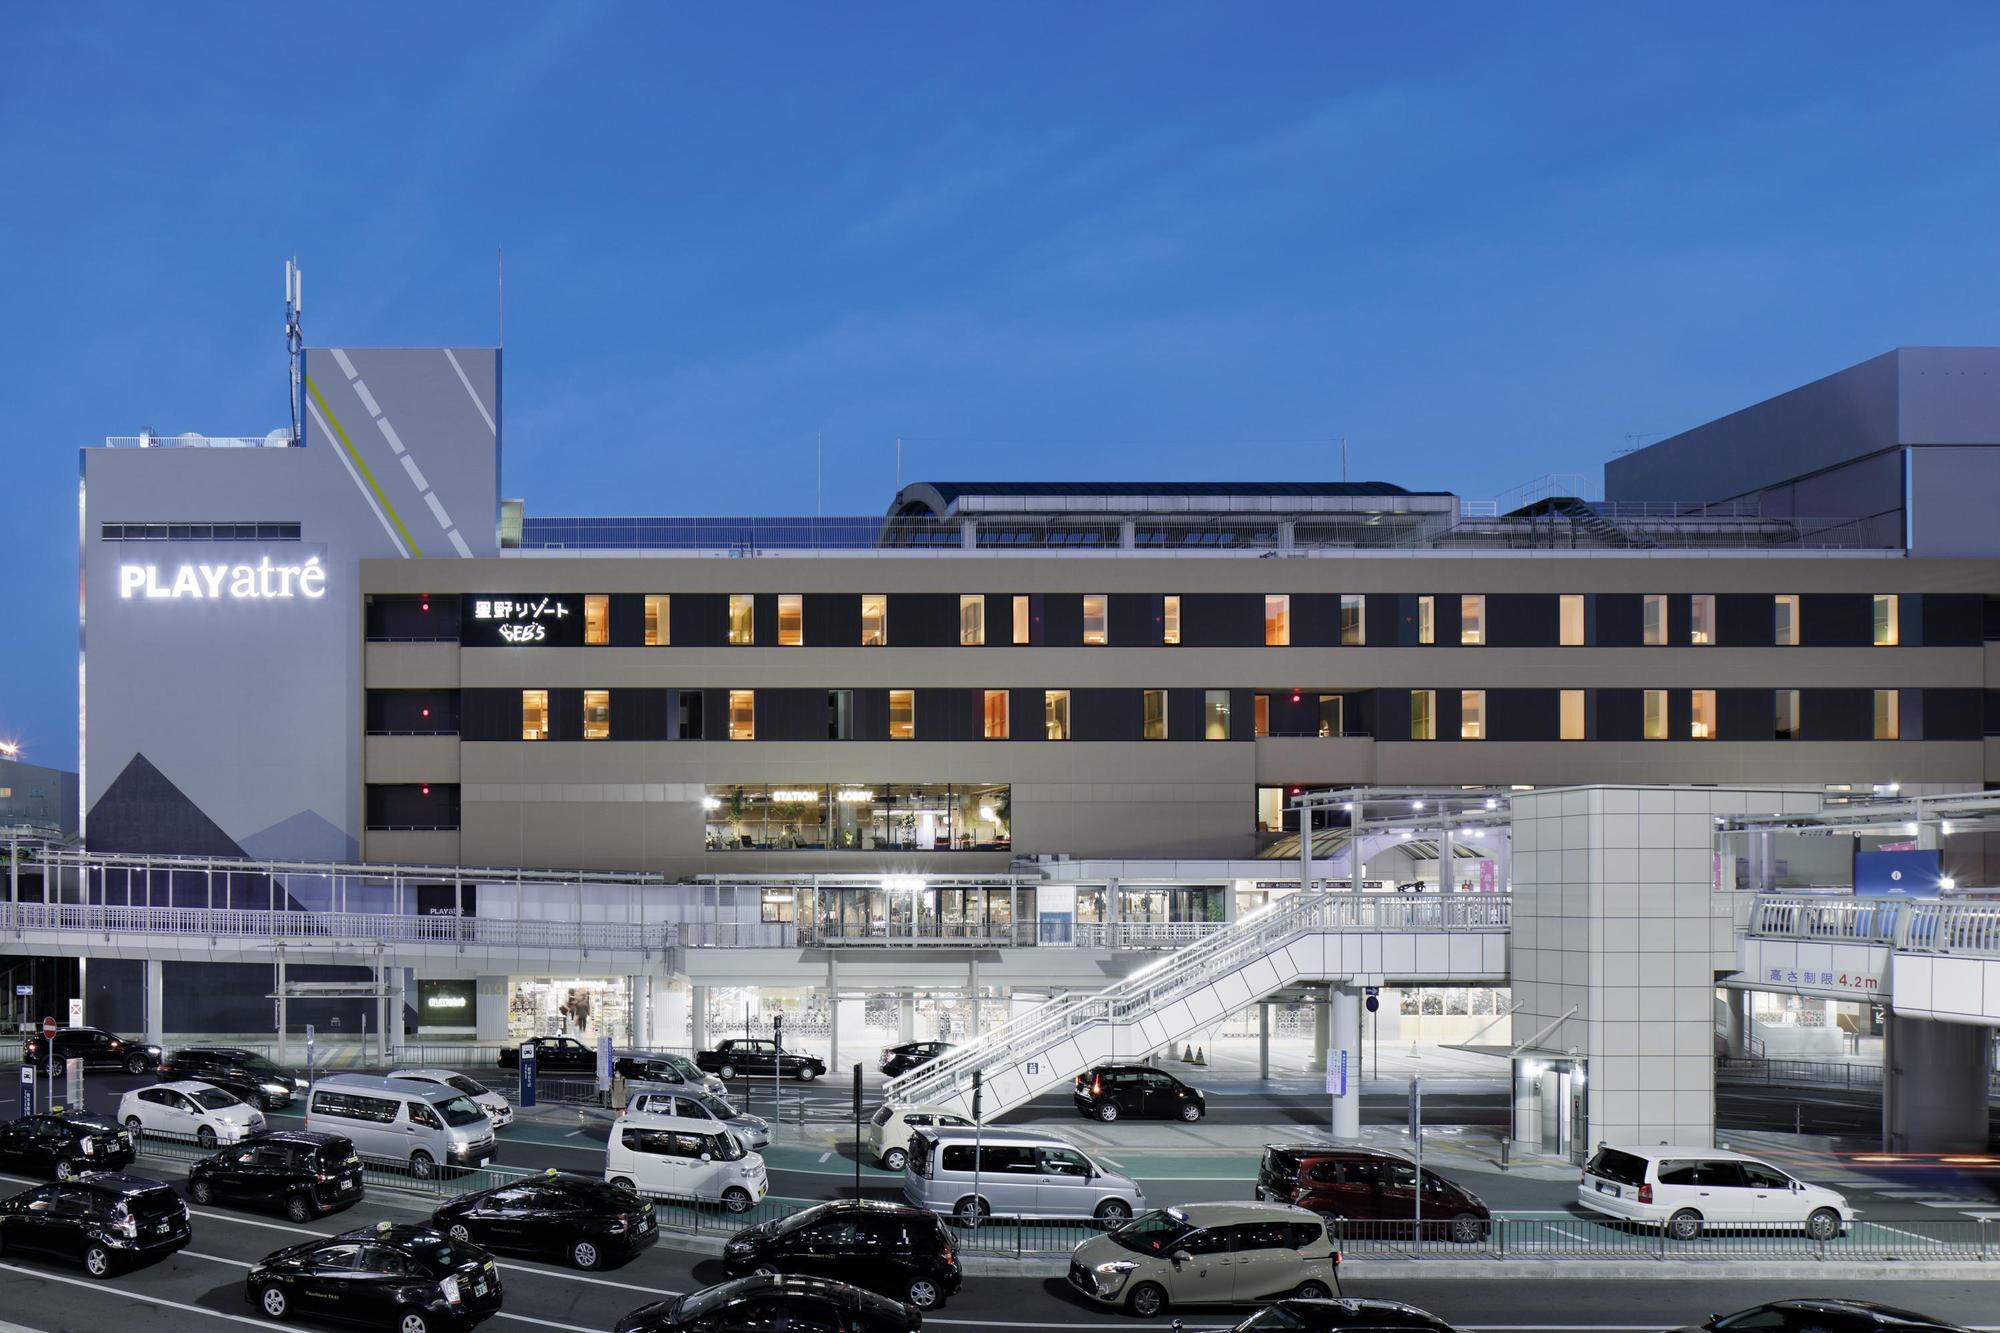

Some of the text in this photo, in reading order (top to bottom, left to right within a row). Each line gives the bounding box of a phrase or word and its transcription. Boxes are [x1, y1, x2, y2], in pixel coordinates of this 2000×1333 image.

[120, 556, 325, 598] PLAYatré
[475, 597, 569, 618] 星野リゾート
[773, 791, 873, 802] STATION LOBBY
[1770, 969, 1878, 989] 高さ制限 4.2m
